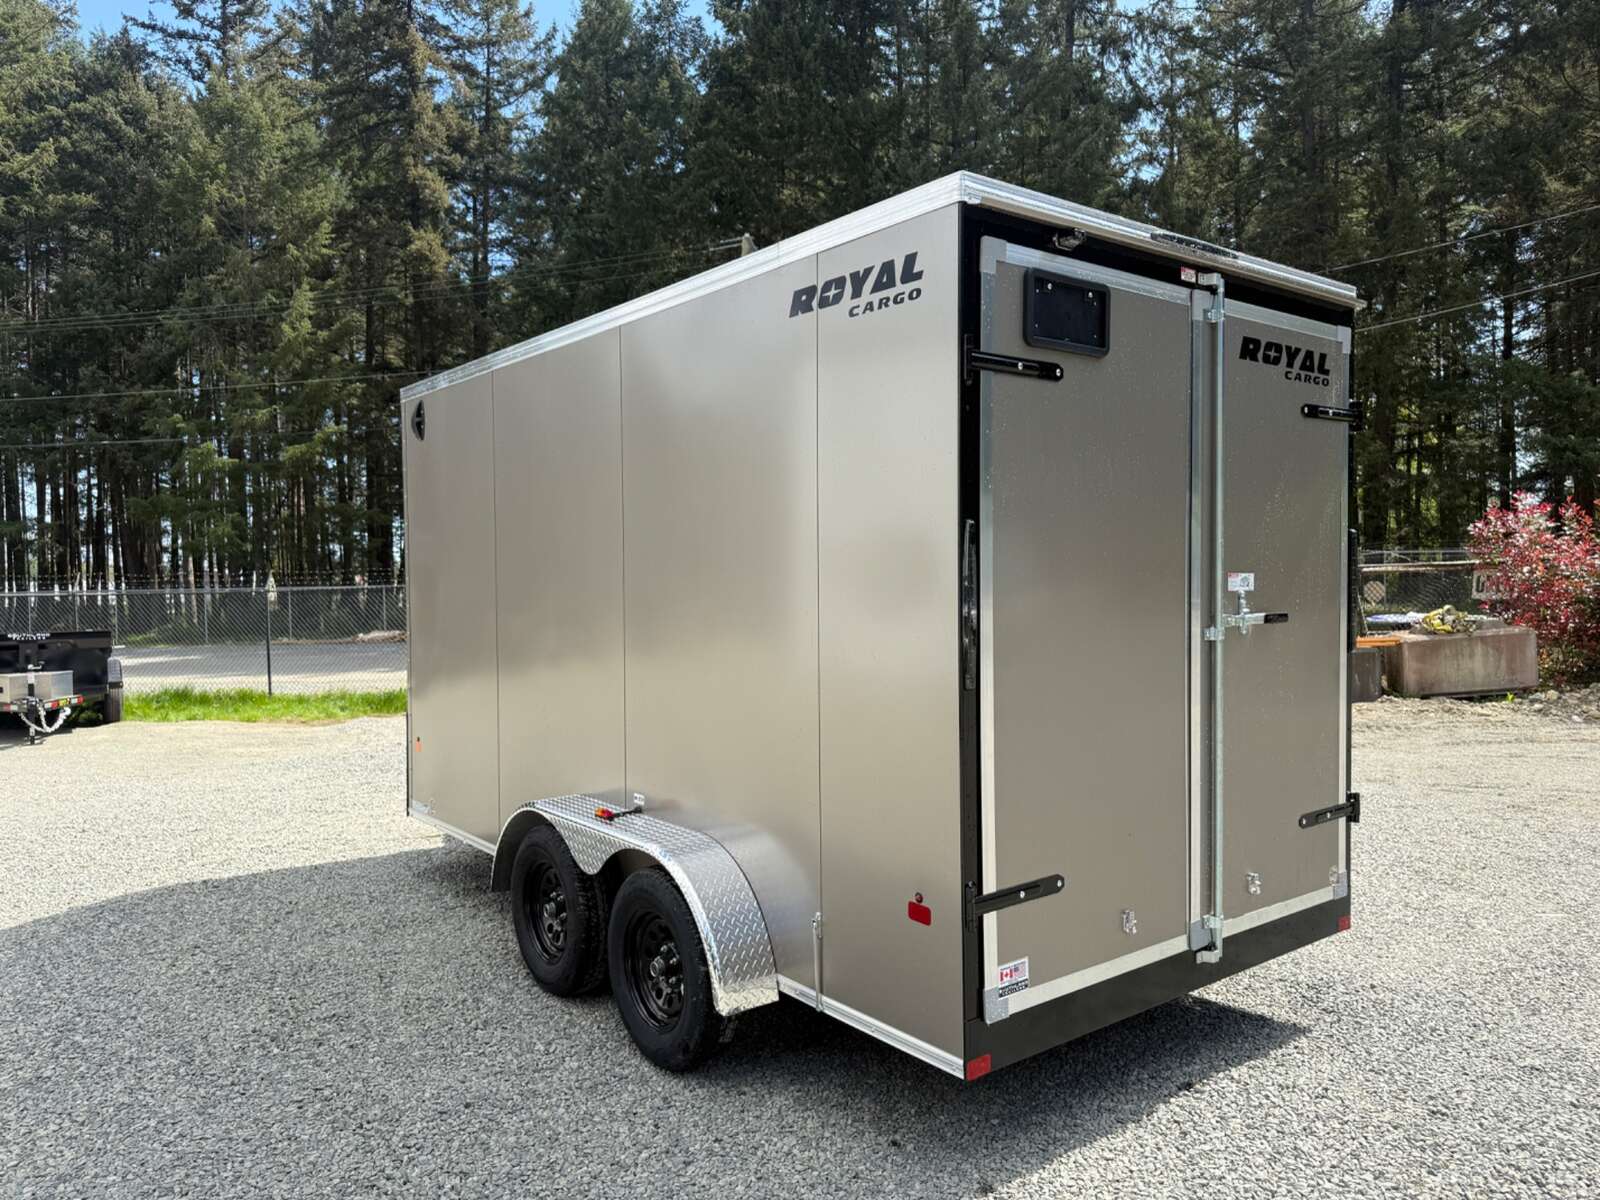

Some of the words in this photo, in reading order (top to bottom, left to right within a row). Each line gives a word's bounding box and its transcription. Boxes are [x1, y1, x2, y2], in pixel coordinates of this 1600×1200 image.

[789, 251, 924, 318] ROYAL
[848, 288, 922, 318] CARGO
[1239, 336, 1330, 376] ROYAL
[1284, 371, 1330, 387] CARGO
